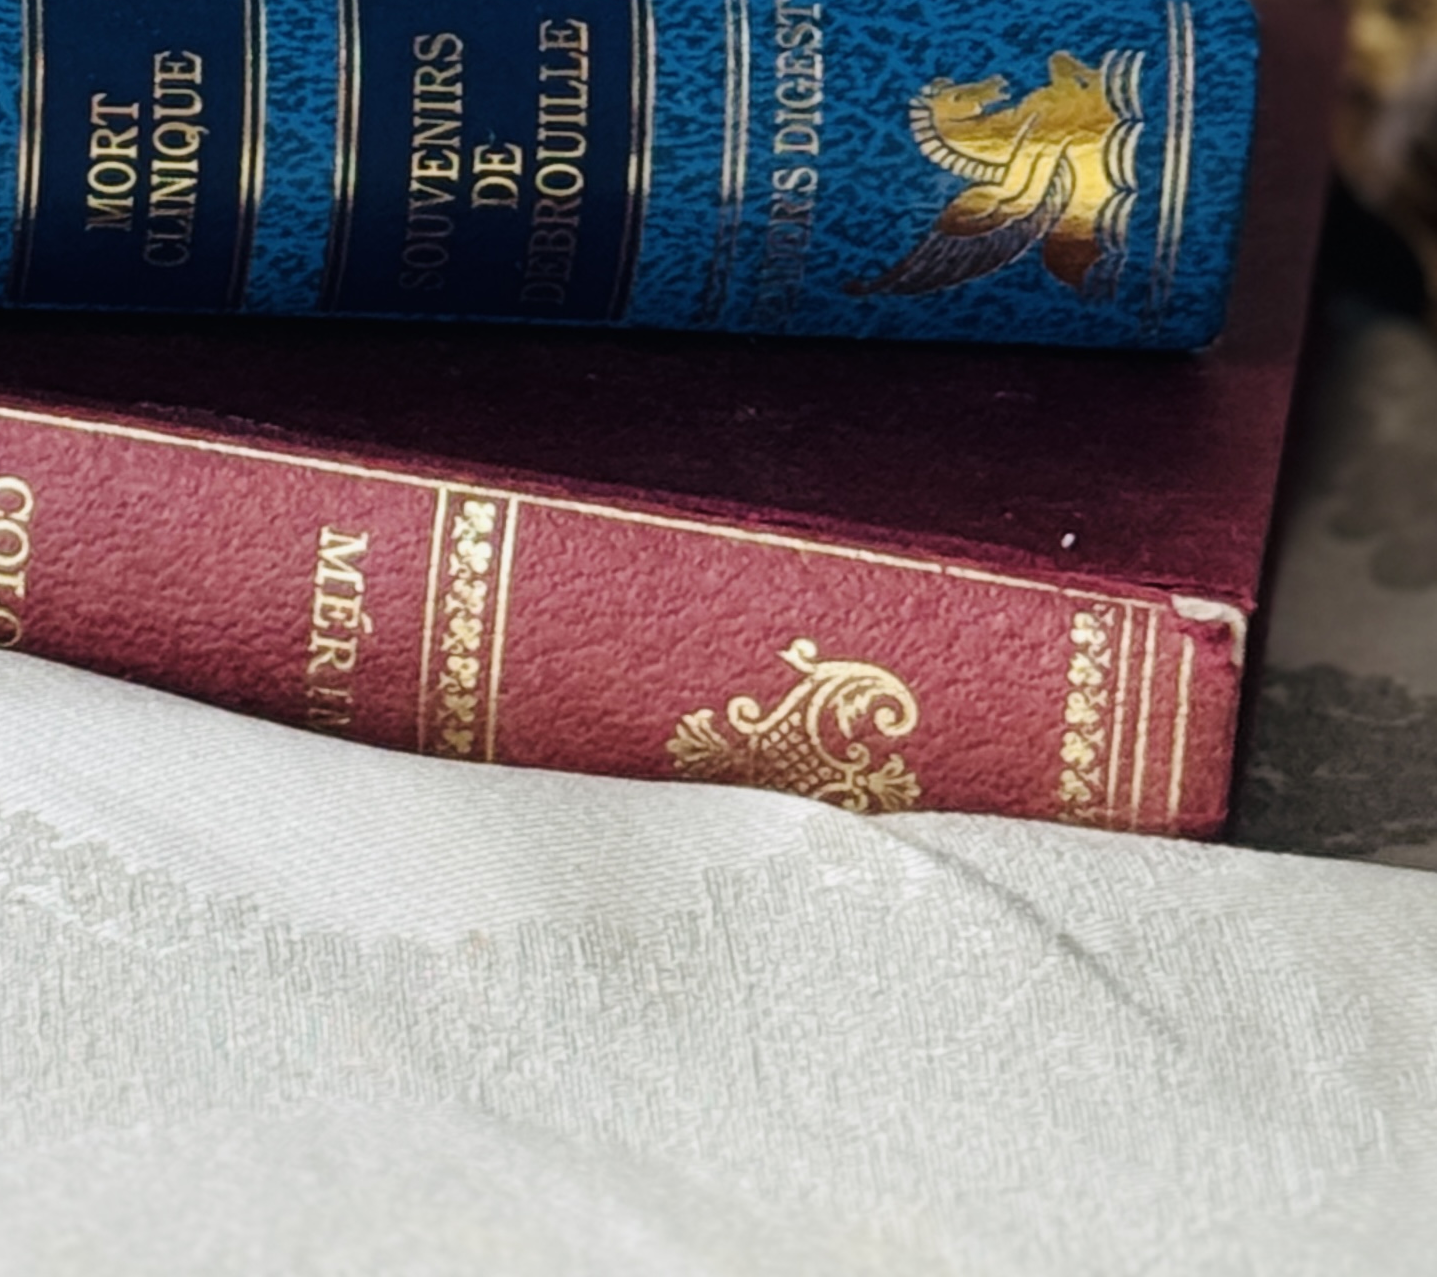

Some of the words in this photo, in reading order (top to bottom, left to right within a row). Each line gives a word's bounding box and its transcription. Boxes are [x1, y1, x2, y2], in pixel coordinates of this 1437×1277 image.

[84, 92, 141, 233] MORT
[142, 48, 211, 268] CLINIQUE
[399, 31, 464, 292] SOUVENIRS
[470, 142, 524, 209] DE
[516, 18, 590, 305] DÉBROUILLE
